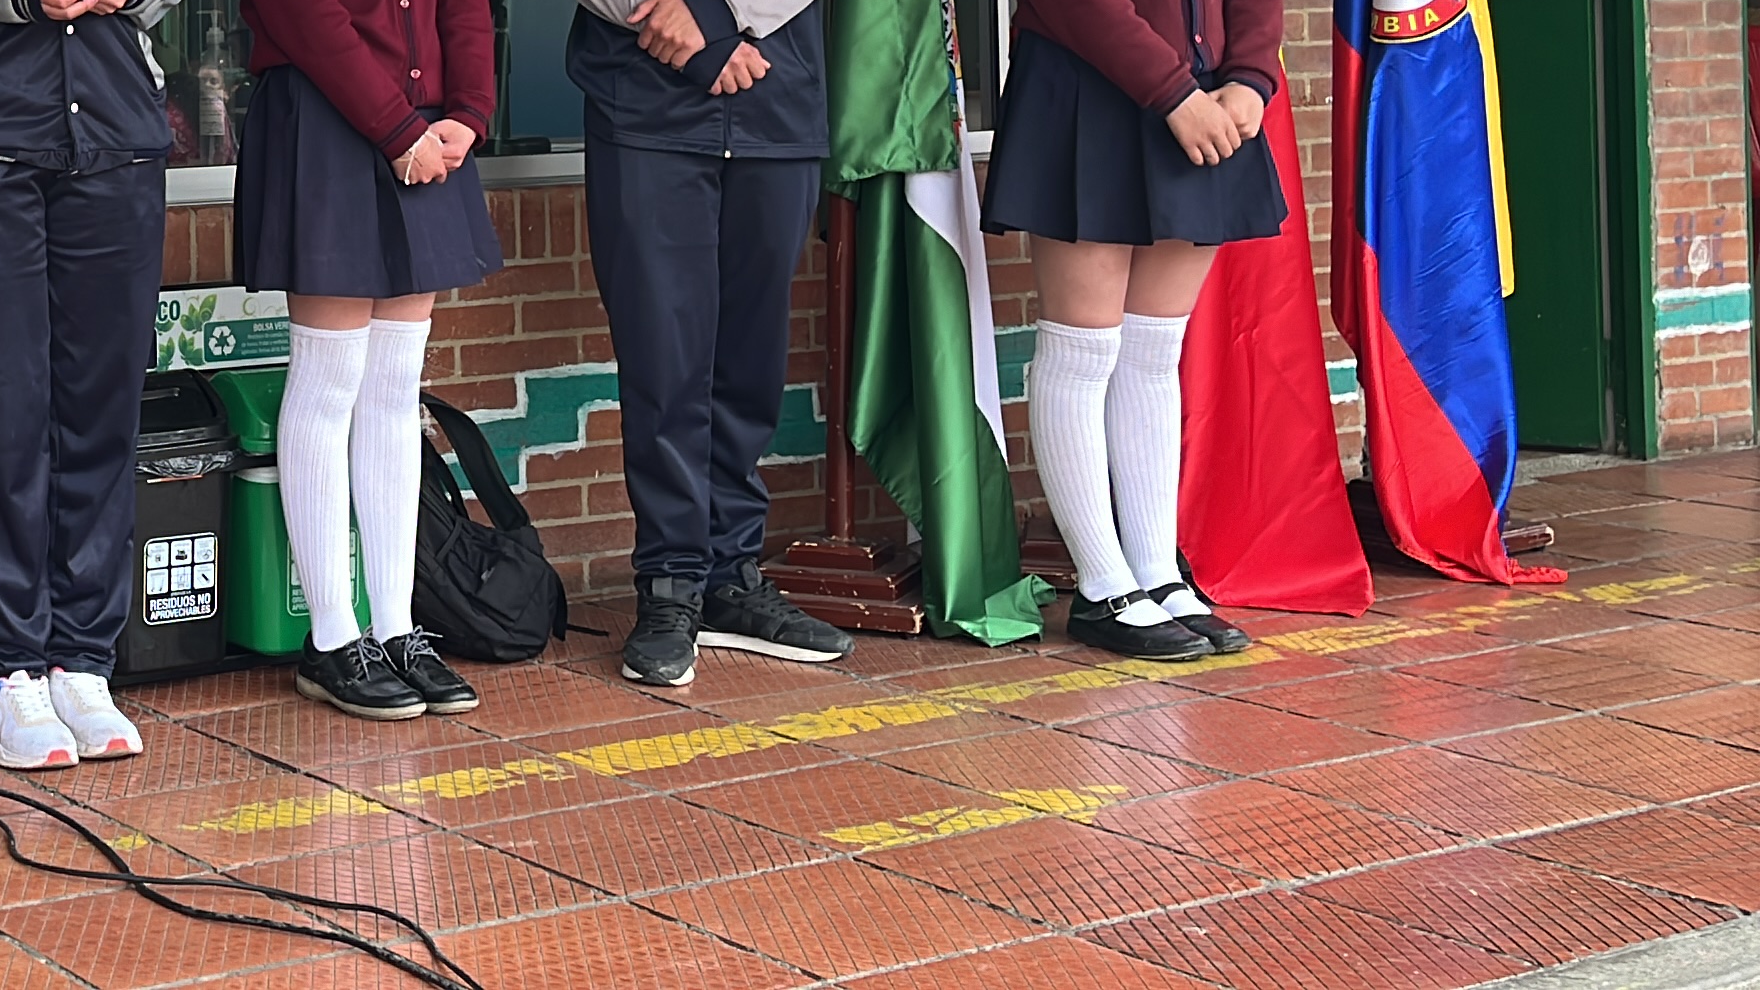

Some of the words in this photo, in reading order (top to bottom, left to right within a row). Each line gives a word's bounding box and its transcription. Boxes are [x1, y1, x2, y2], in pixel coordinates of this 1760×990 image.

[253, 322, 273, 332] BOLSA
[149, 595, 195, 612] RESIDUOS
[197, 593, 211, 605] NO
[150, 604, 211, 621] APROVECHABLES
